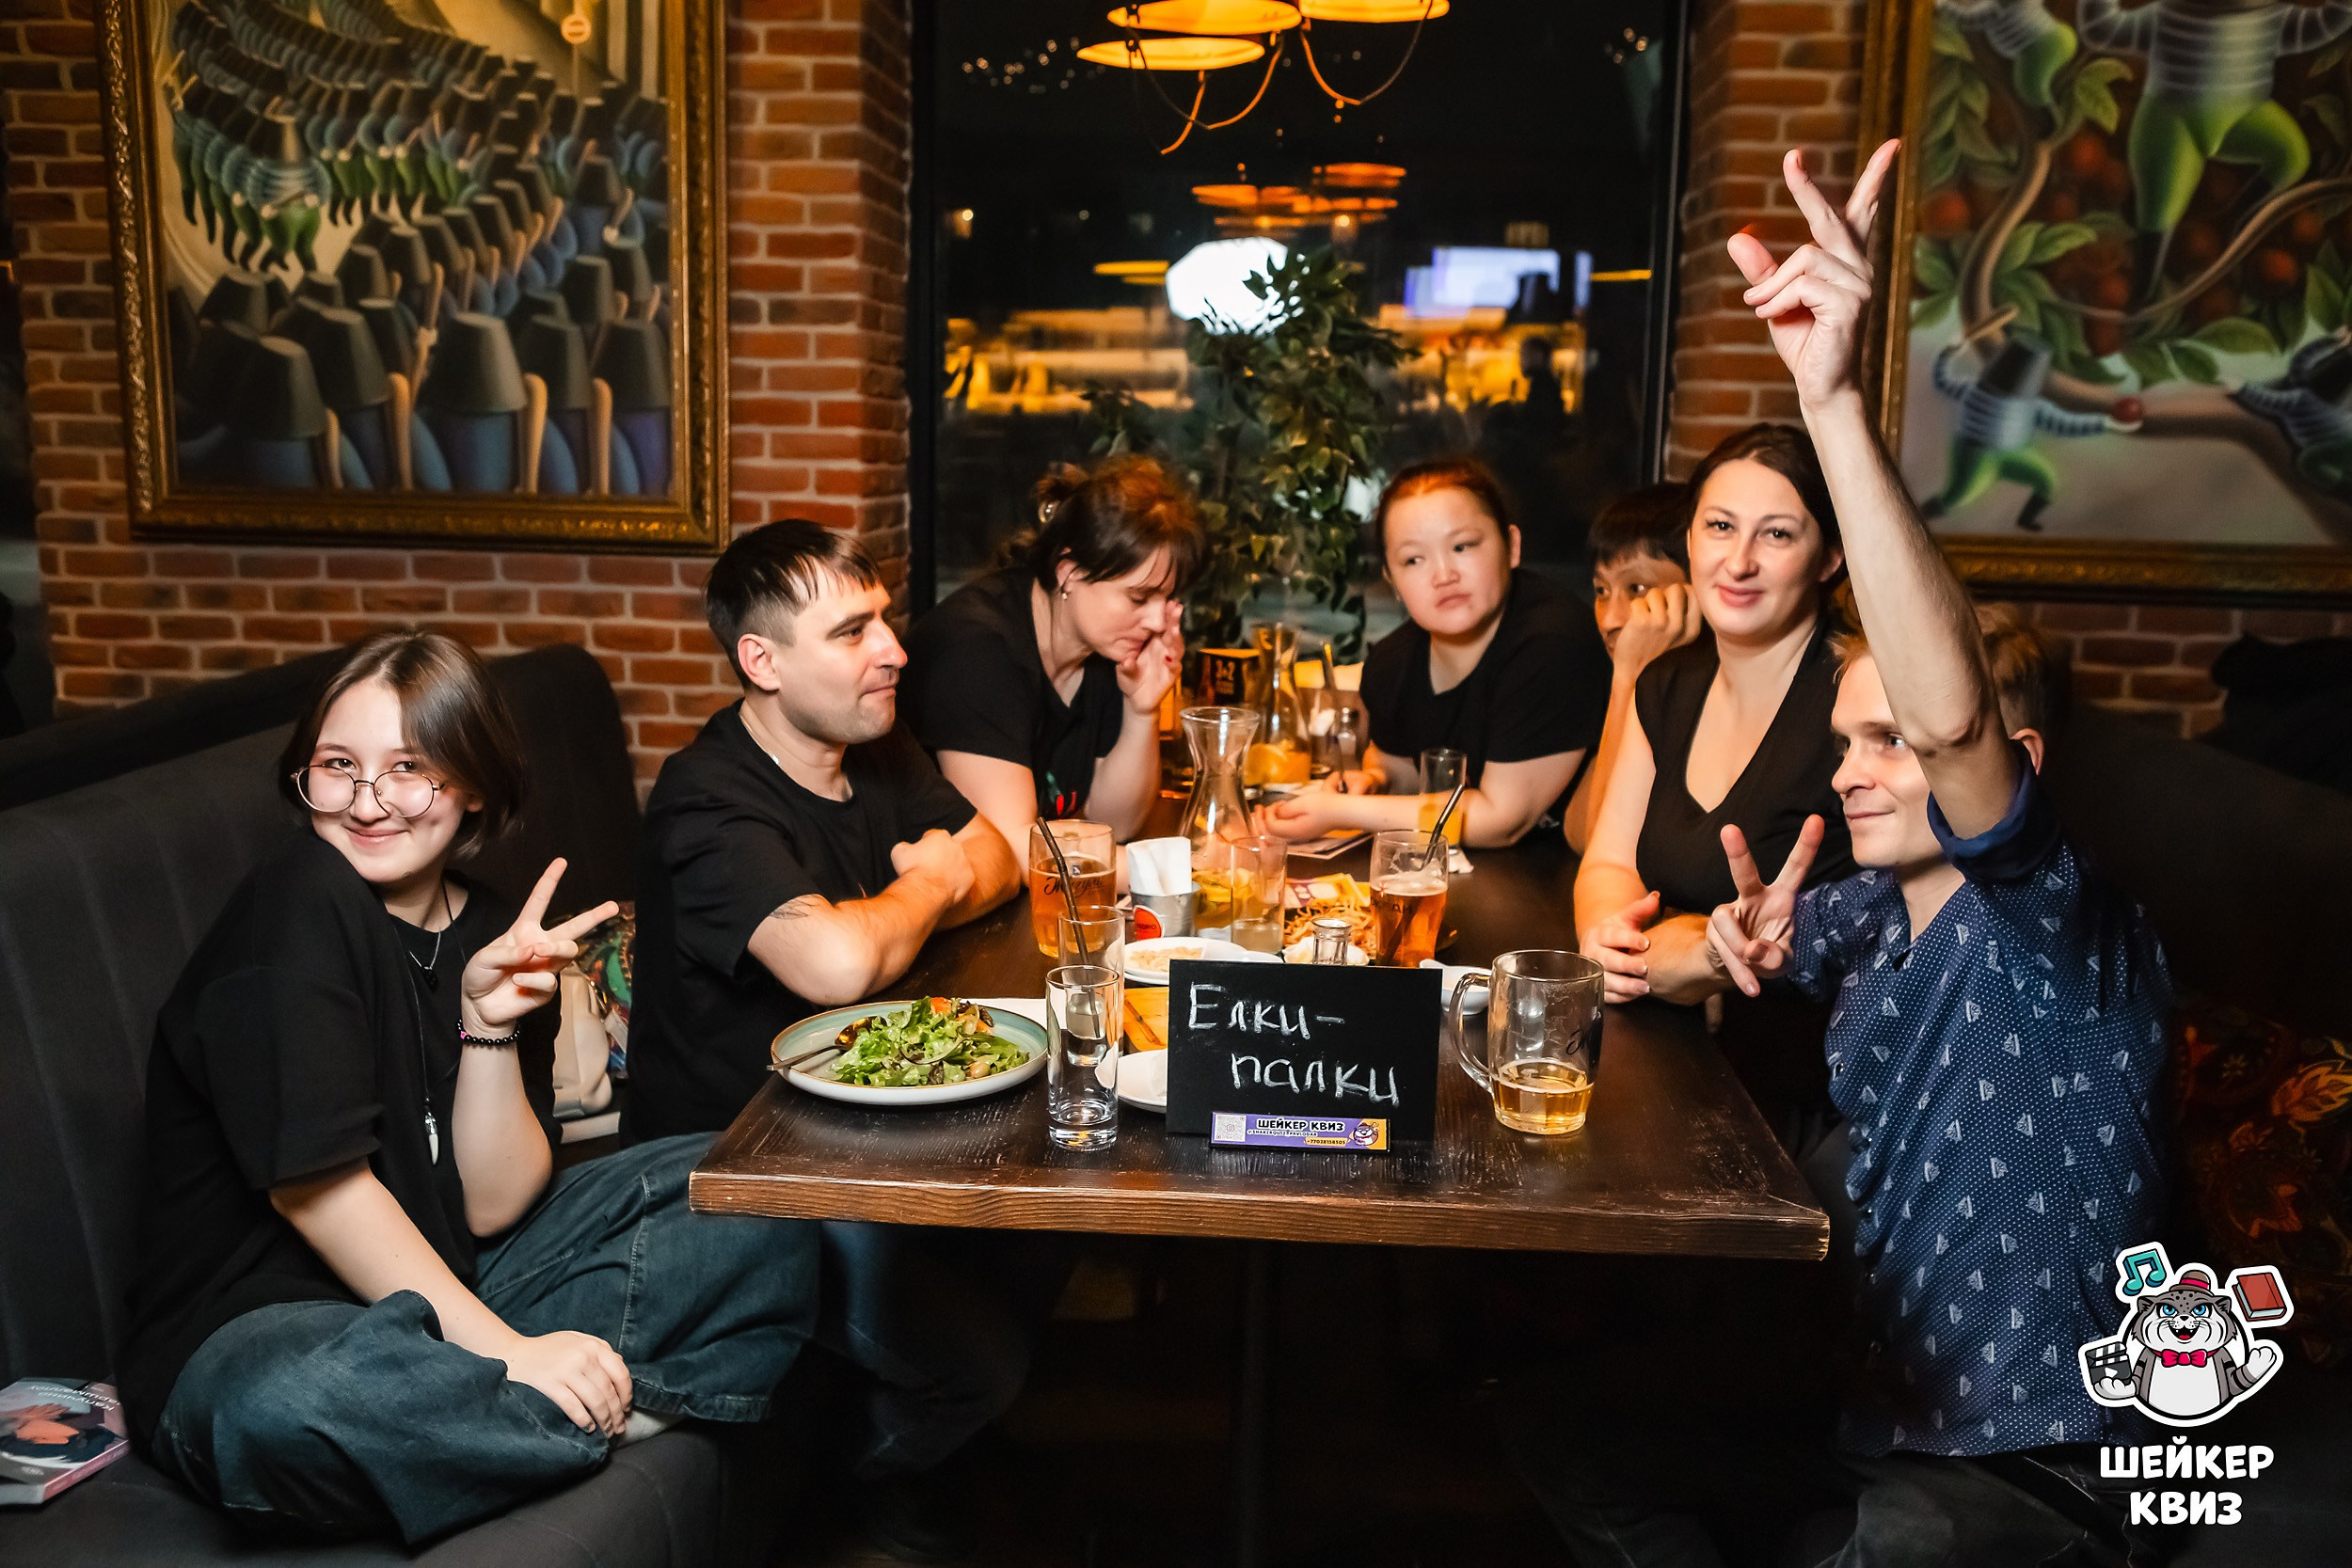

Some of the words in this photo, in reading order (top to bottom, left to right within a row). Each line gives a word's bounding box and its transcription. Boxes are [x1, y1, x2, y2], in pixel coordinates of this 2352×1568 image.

[1188, 982, 1344, 1040] Елки-
[1232, 1053, 1400, 1108] палки
[1257, 1117, 1308, 1131] ШЕЙКЕР
[1311, 1122, 1344, 1132] КВИЗ
